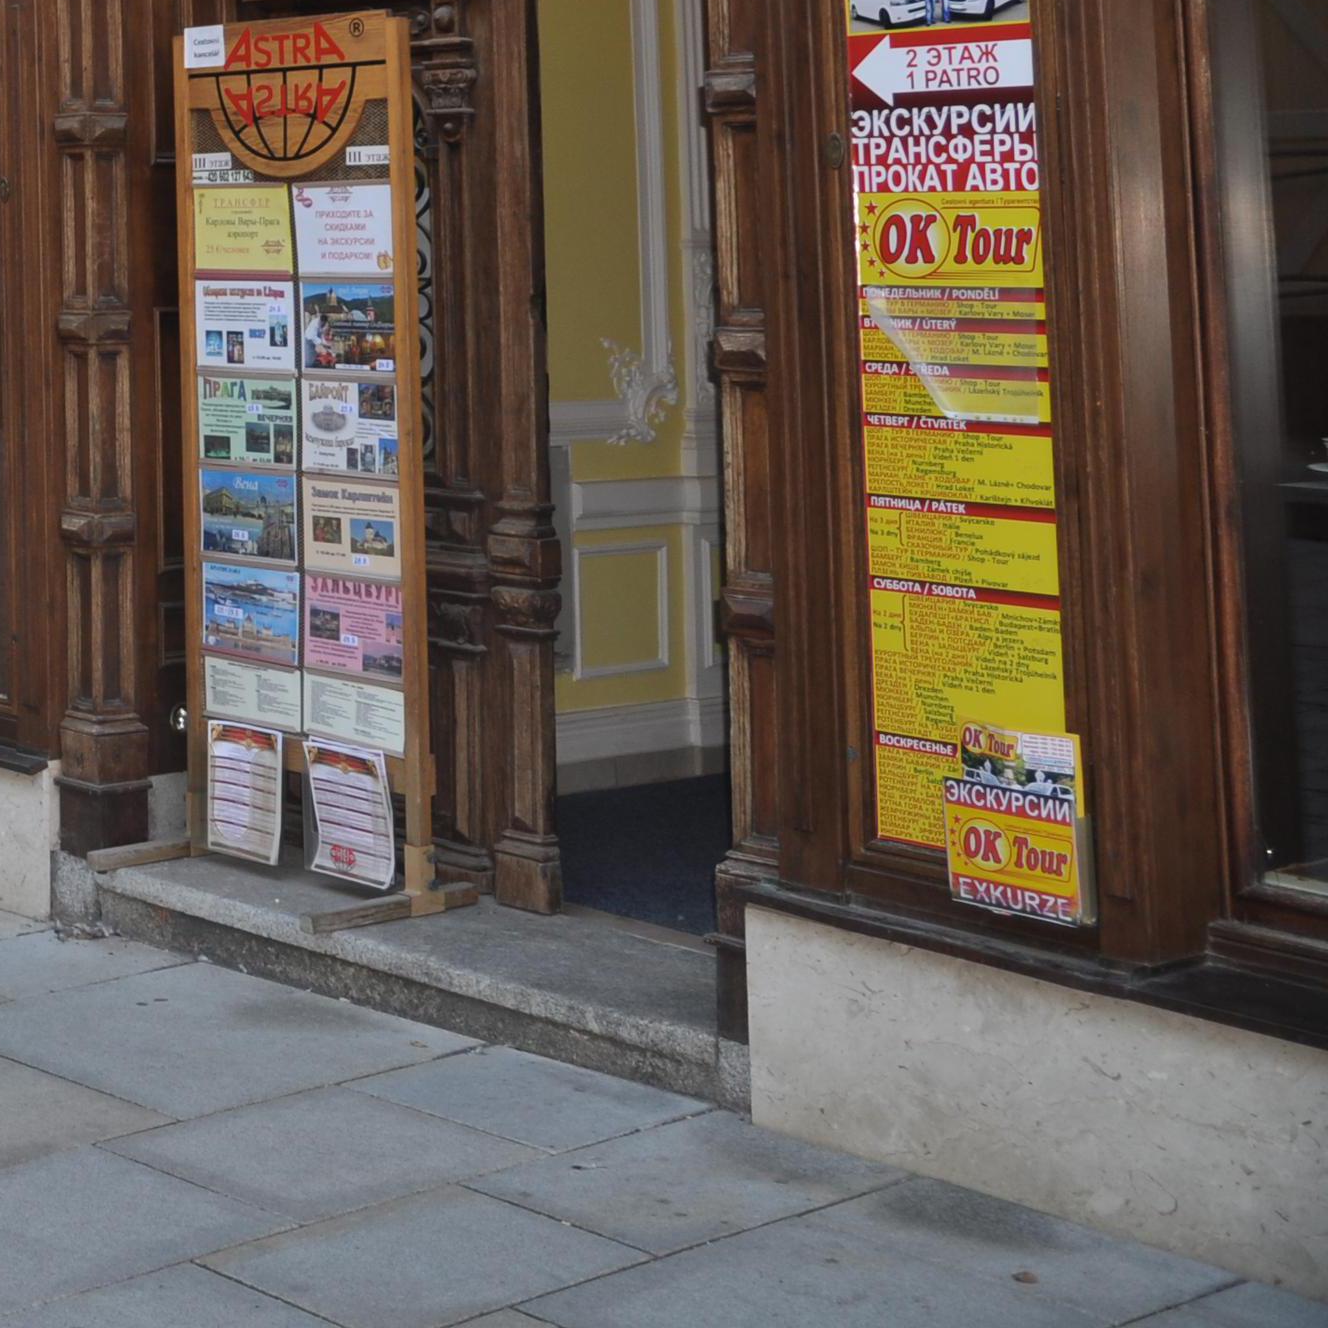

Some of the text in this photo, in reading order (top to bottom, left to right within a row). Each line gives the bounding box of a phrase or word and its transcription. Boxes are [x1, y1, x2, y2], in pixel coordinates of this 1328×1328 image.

[223, 21, 346, 71] ASTRA
[905, 43, 999, 68] 2 ЭТАЖ
[905, 66, 999, 90] 1 PATRO
[851, 102, 1036, 137] ЭКСКУРСИИ
[852, 132, 1038, 164] ТРАНСФЕРЫ
[852, 161, 1039, 192] ПРОКАТ АВТО
[315, 209, 374, 219] ПРИХОДИТЕ ЗА
[324, 222, 366, 232] СКИДКАМИ
[318, 237, 375, 246] НА ЭКСКУРСИИ
[879, 213, 1033, 265] OK Tour
[327, 252, 373, 261] ПОДАРКОМ!
[953, 287, 999, 300] PONDĚLÍ
[922, 317, 956, 330] ÚTERÝ
[865, 363, 899, 375] СРЕДА
[204, 375, 247, 402] ПРАГА
[867, 415, 909, 427] ЧЕТВЕРГ
[311, 486, 339, 500] Замок
[870, 496, 966, 514] ПЯТНИЦА PÁTEK
[873, 577, 976, 598] СУББОТА SOBOTA
[879, 733, 954, 755] ВОСКРЕСЕНЬЕ
[946, 780, 1070, 822] ЭКСКУРСИИ
[963, 826, 1068, 877] OK Tour
[959, 878, 1073, 922] EXKURZE
